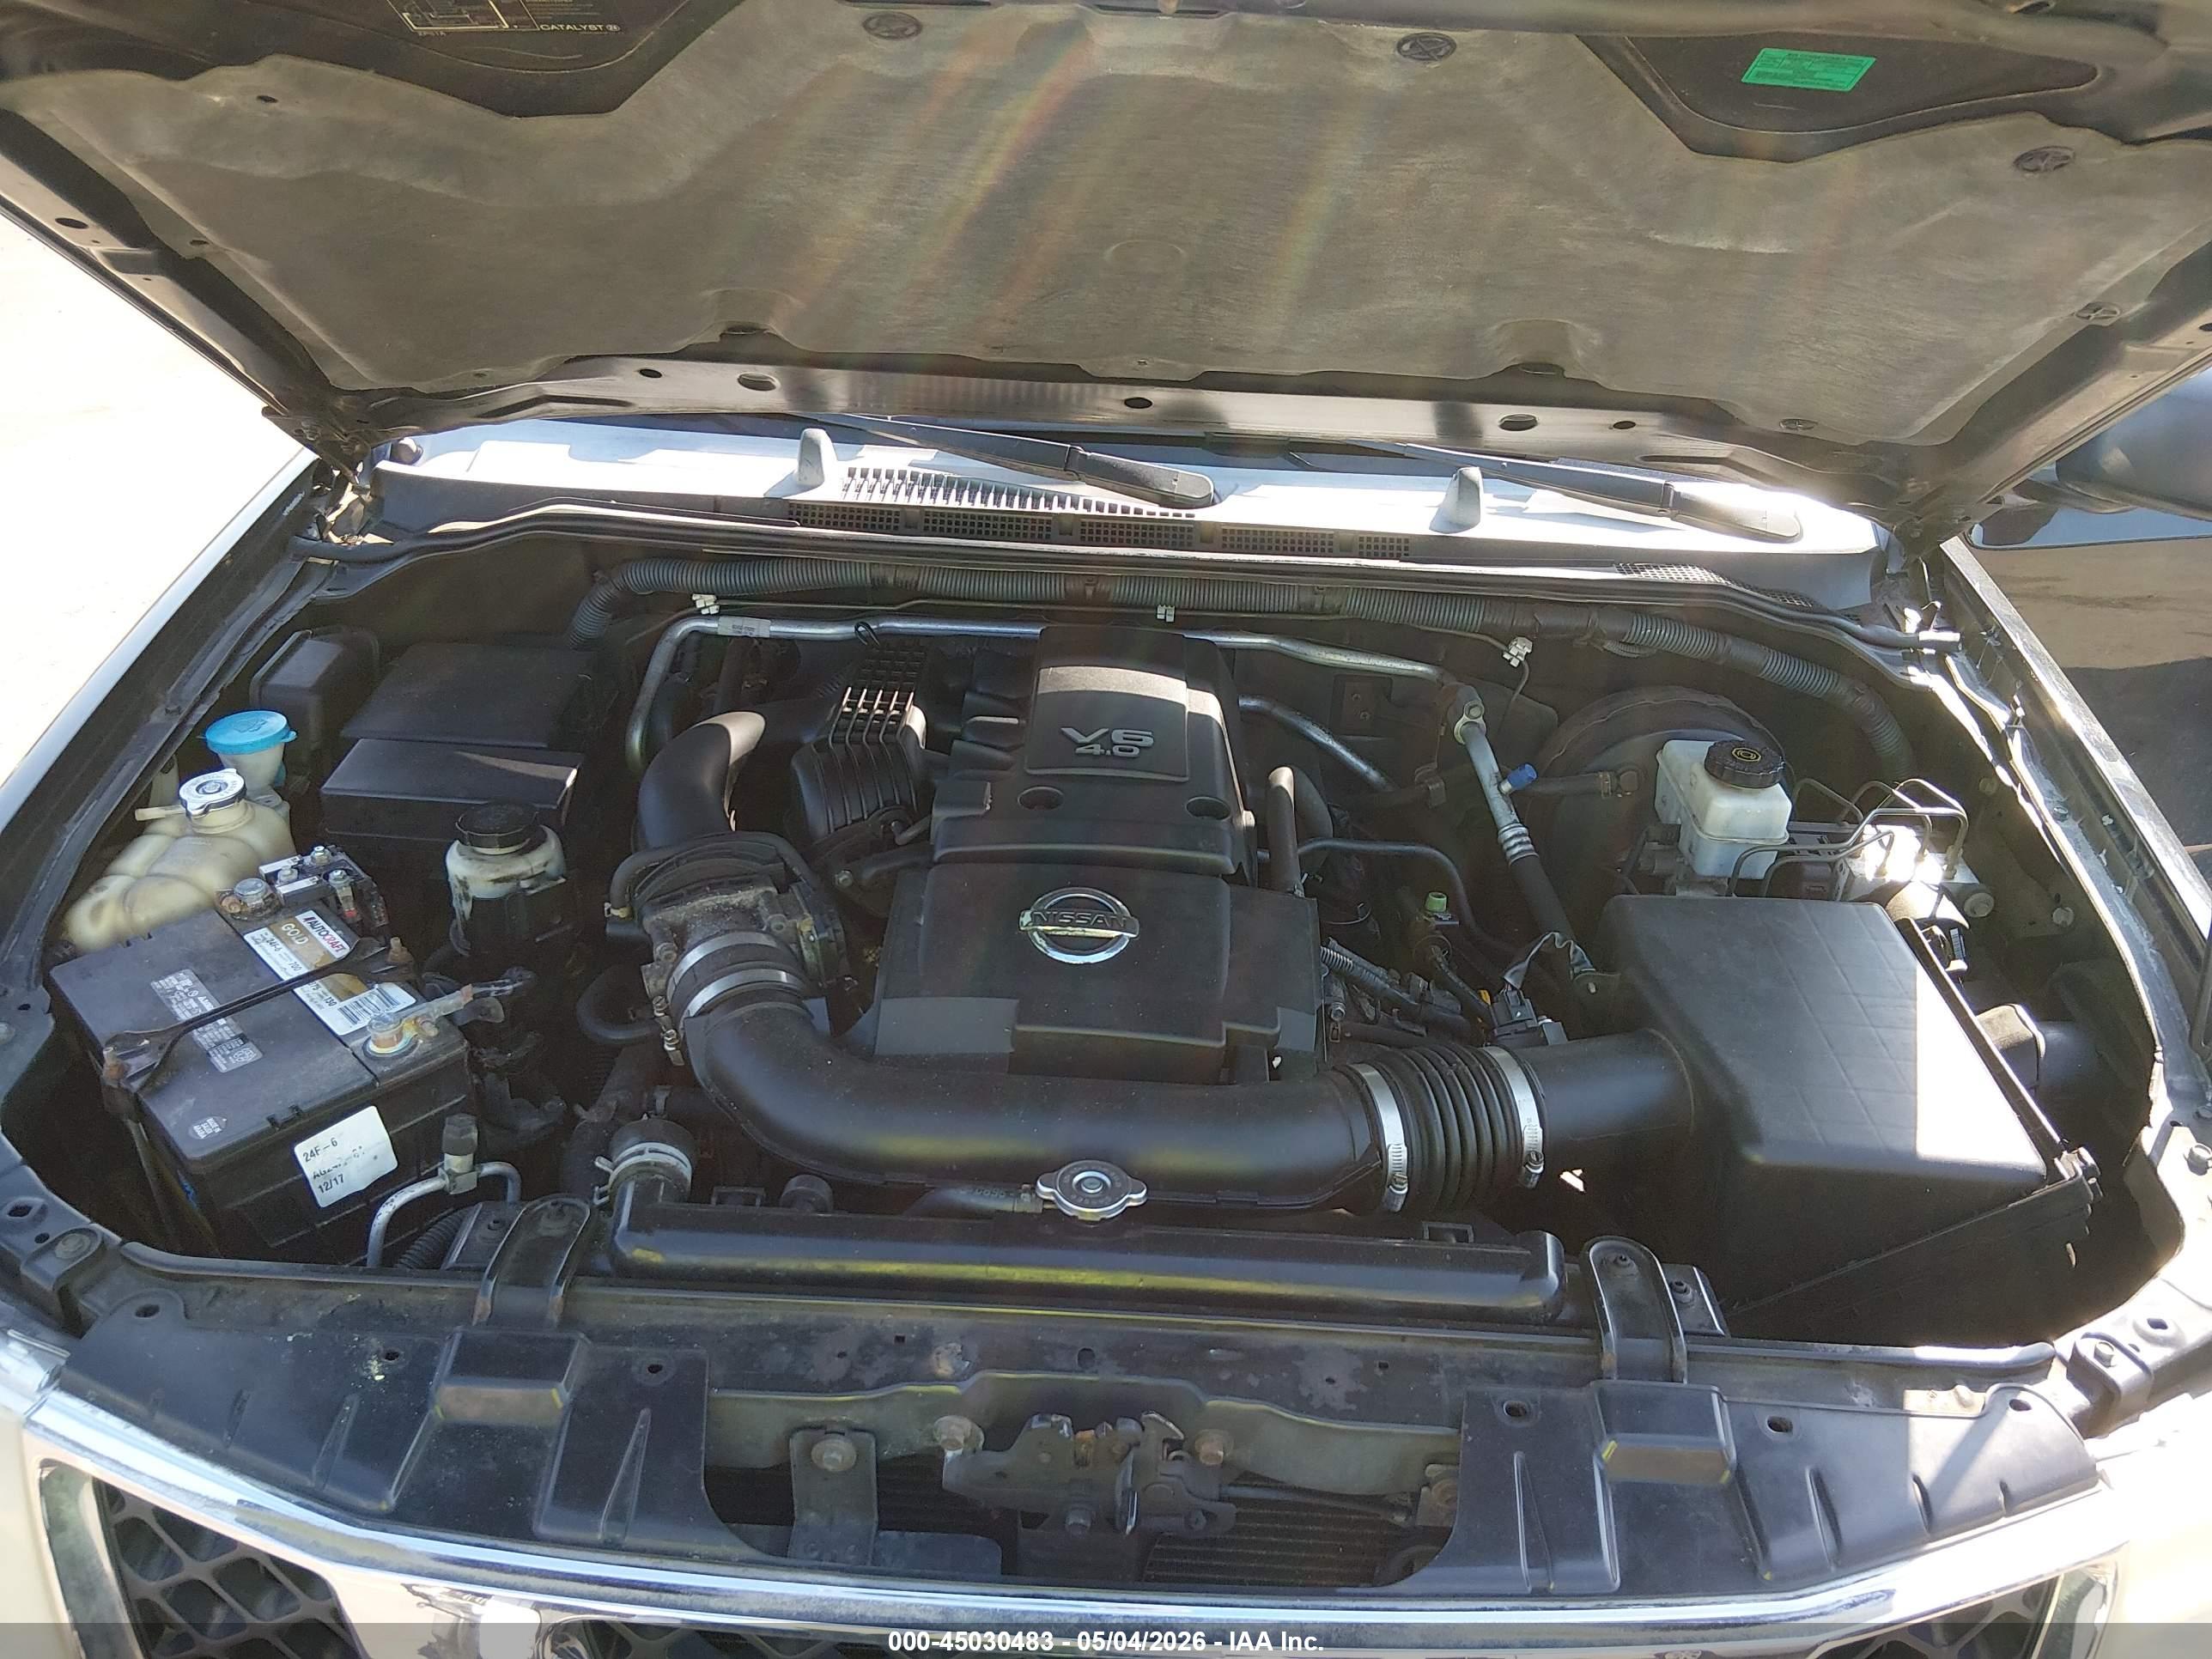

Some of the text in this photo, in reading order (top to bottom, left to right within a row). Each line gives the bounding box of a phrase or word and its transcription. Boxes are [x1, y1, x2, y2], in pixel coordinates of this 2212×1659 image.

[1060, 727, 1154, 747] V6
[1075, 744, 1140, 757] 4.0
[1031, 910, 1128, 928] NISSAN
[281, 922, 310, 945] GOLD
[307, 918, 347, 953] AUTOCRAFT
[324, 996, 337, 1008] 130
[317, 1173, 345, 1194] 12/17
